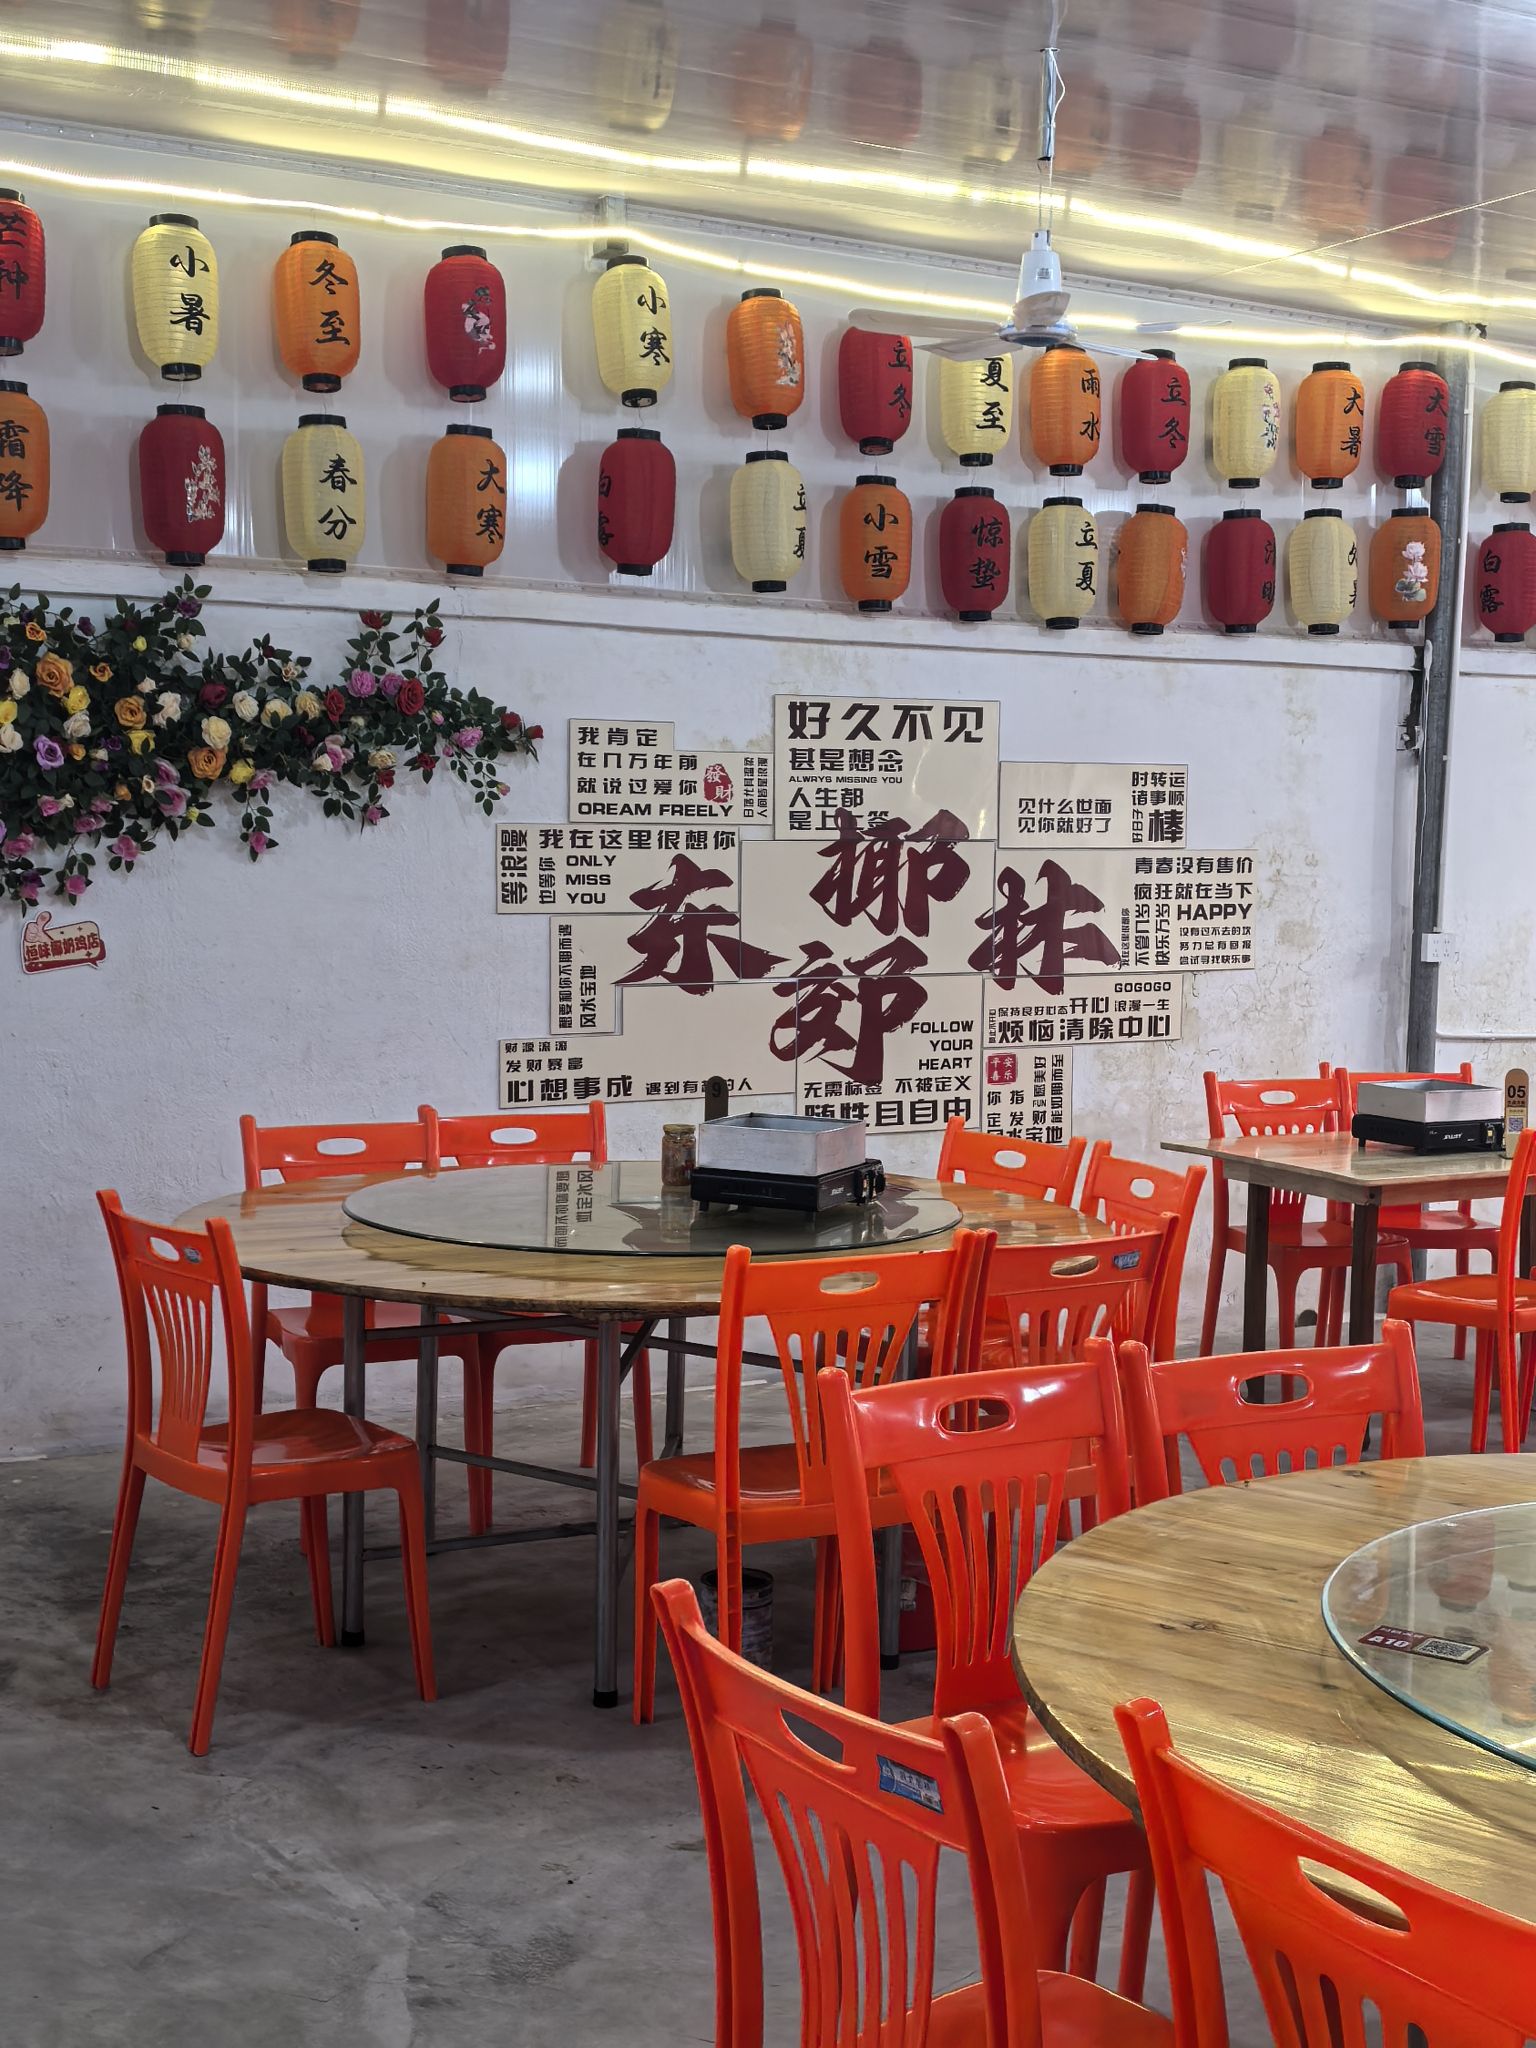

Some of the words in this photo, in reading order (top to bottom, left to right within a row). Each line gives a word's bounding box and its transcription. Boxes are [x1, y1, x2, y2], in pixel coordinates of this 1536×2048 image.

[170, 246, 210, 336] 小暑
[309, 259, 351, 346] 冬至
[637, 286, 670, 366] 小寒
[976, 357, 1009, 433] 夏至
[1080, 369, 1100, 441] 雨水
[1158, 377, 1186, 448] 立冬
[1341, 387, 1363, 457] 大暑
[1424, 387, 1447, 456] 大雪
[0, 420, 33, 511] 霜降
[318, 454, 357, 540] 春分
[476, 459, 505, 544] 大寒
[864, 504, 898, 578] 小雪
[970, 517, 1003, 590] 惊蛰
[1075, 521, 1098, 595] 立夏
[1479, 550, 1504, 612] 白露
[787, 701, 984, 743] 好久不见
[578, 726, 658, 747] 我肯定
[577, 751, 698, 770] 在几万年前
[789, 748, 903, 772] 甚是想念
[577, 777, 698, 795] 就说过爱你
[757, 757, 768, 818] 人间皆是浪漫
[836, 776, 877, 784] MISSING
[1132, 771, 1186, 787] 时转运
[789, 787, 864, 808] 人生都
[1018, 798, 1112, 815] 见什么世面
[1132, 790, 1184, 806] 诸事顺
[659, 804, 733, 817] FREELY
[1018, 817, 1112, 834] 见你就好了
[1132, 808, 1143, 843] 好日子
[1148, 809, 1184, 843] 棒
[539, 829, 737, 850] 我在这里很想你
[500, 829, 528, 905] 等浪漫
[566, 855, 617, 867] ONLY
[1135, 857, 1254, 874] 青春没有售价
[539, 857, 556, 905] 也等你
[565, 874, 611, 886] MISS
[567, 893, 606, 905] YOU
[1134, 883, 1253, 900] 疯狂就在当下
[1177, 904, 1252, 920] HAPPY
[1135, 904, 1150, 966] 不管几岁
[1155, 904, 1170, 965] 快乐万岁
[1179, 926, 1252, 937] 没有过不去的坎
[1179, 940, 1252, 951] 努力总有回报
[558, 923, 573, 1029] 想要和你不期而遇
[579, 964, 597, 1029] 风水宝地
[1114, 982, 1171, 993] GOGOGO
[998, 1006, 1068, 1017] 保持良好心态
[1069, 997, 1109, 1014] 开心
[1114, 999, 1170, 1011] 浪漫一生
[911, 1021, 974, 1033] FOLLOW
[998, 1015, 1171, 1043] 烦恼清除中心
[505, 1040, 568, 1054] 财源滚滚
[930, 1039, 973, 1051] YOUR
[506, 1057, 583, 1073] 发财暴富
[919, 1057, 972, 1070] HEART
[507, 1075, 633, 1104] 心想事成
[645, 1077, 753, 1096] 遇到有的人
[895, 1076, 972, 1093] 不被定义
[1051, 1054, 1063, 1123] 能如期而至
[1508, 1085, 1526, 1098] 05
[1368, 1635, 1409, 1648] A10
